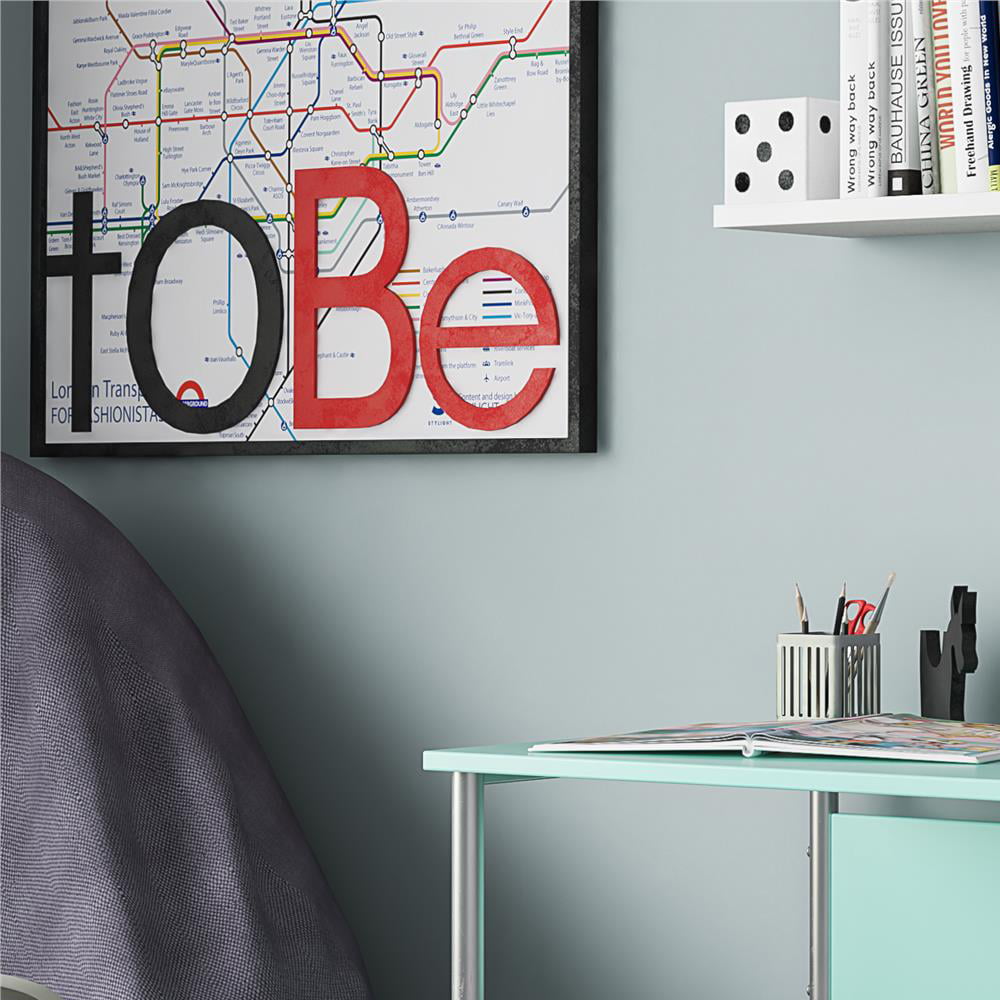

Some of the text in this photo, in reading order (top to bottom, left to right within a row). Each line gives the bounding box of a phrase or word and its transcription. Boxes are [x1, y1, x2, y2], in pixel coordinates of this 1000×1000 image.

[980, 14, 989, 42] World
[981, 44, 991, 66] New
[891, 55, 903, 163] BAUHAUSE
[961, 65, 973, 115] Drawing
[983, 82, 994, 113] Goods
[849, 115, 857, 143] way
[869, 105, 877, 134] way
[914, 37, 934, 189] CHINA GREEN
[984, 115, 998, 150] Alergic
[868, 141, 877, 187] Wrong
[963, 120, 976, 177] Freehand
[848, 149, 857, 193] Wrong
